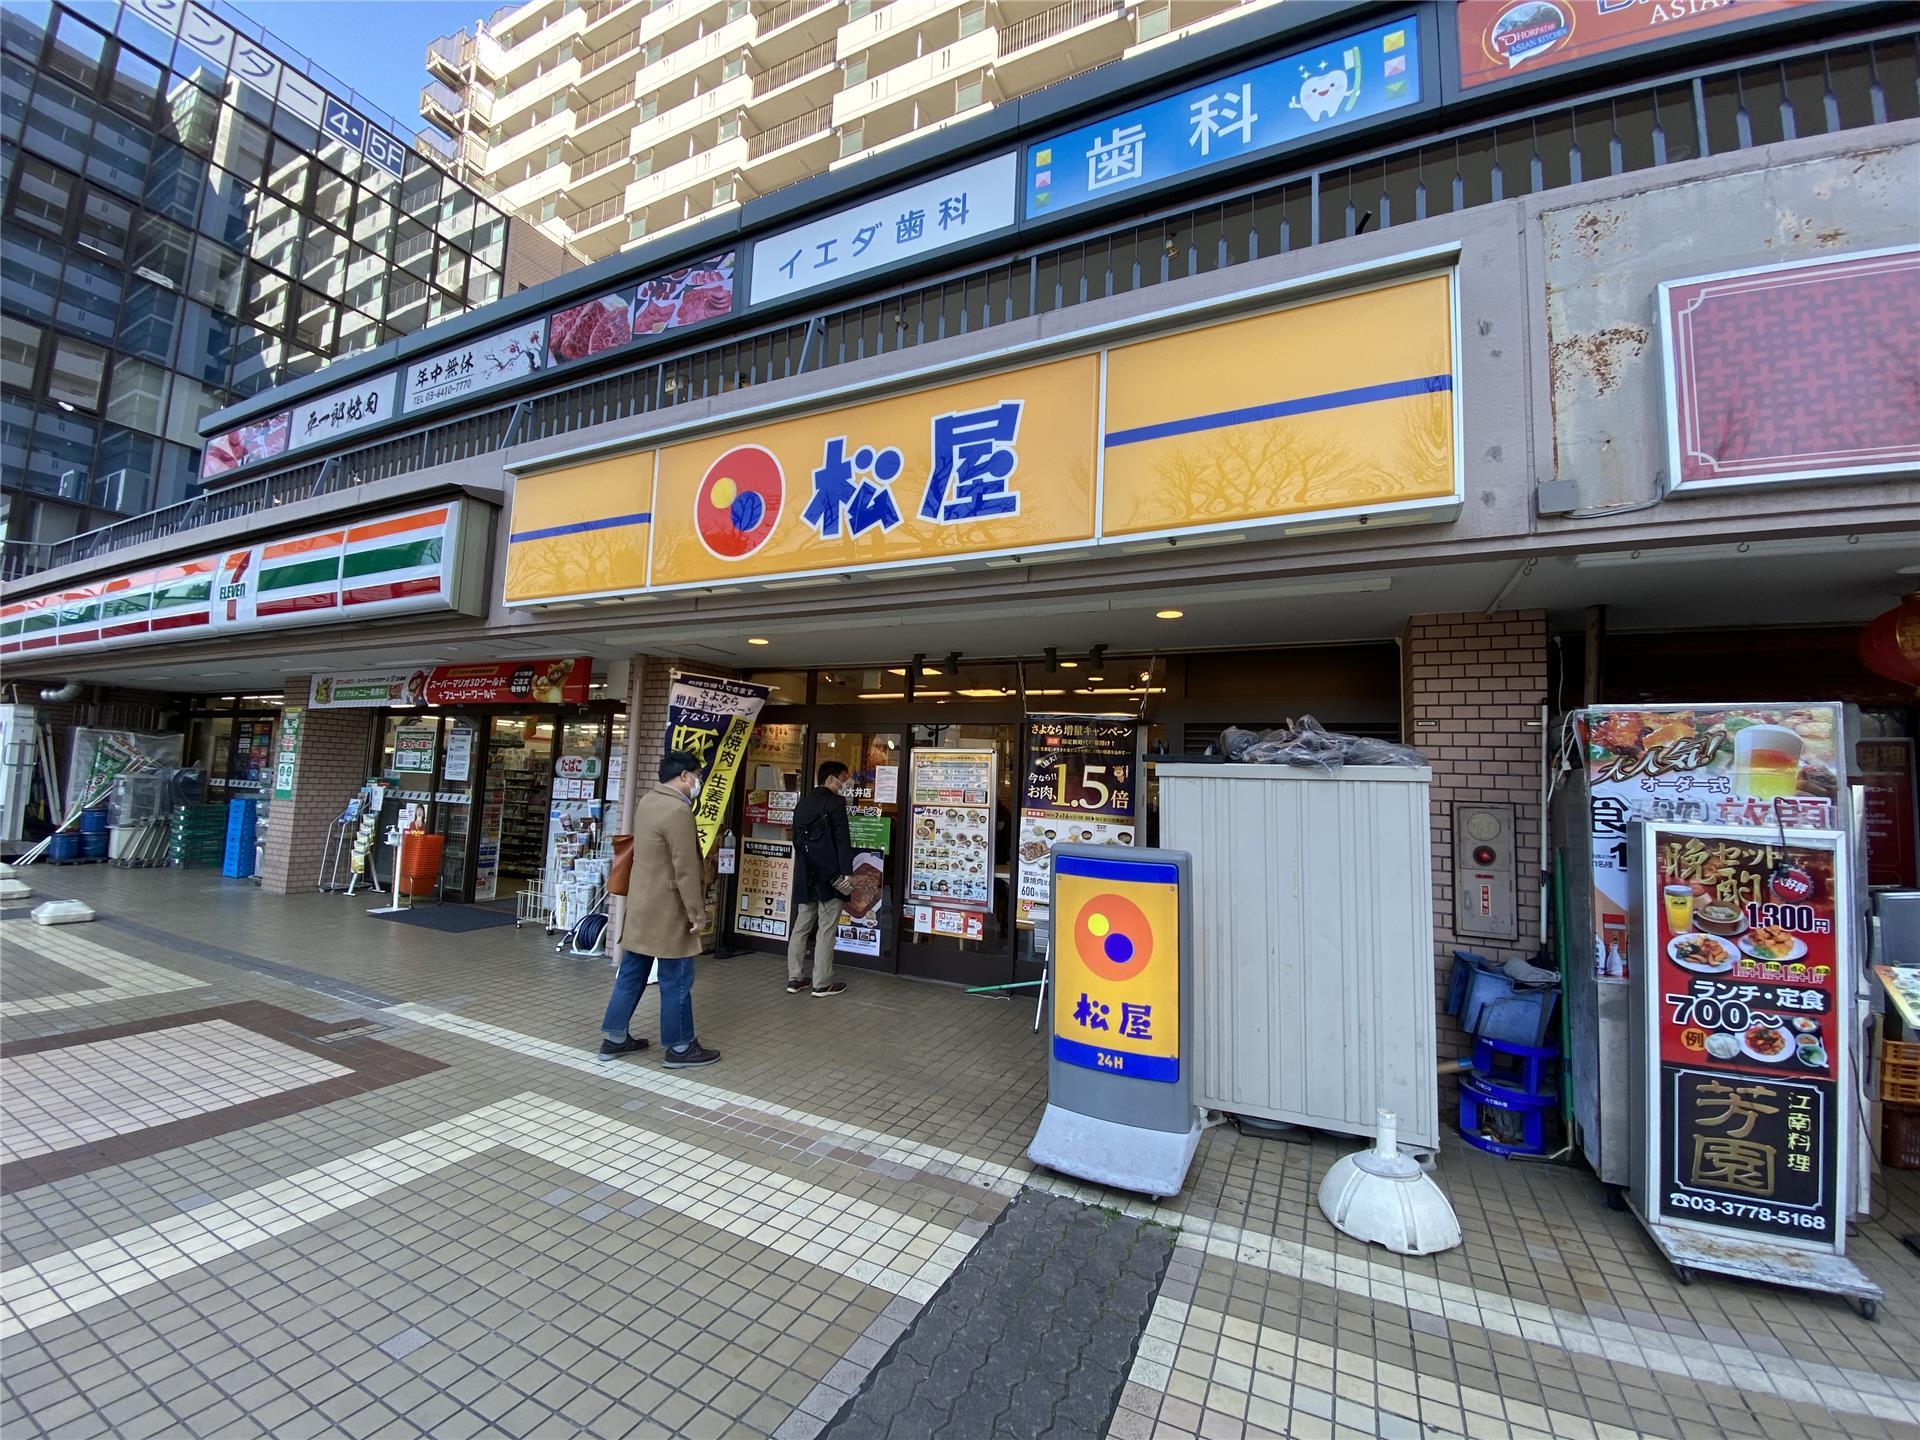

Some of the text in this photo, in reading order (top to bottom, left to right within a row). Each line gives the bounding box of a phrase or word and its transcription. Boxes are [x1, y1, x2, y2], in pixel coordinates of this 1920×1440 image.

[1086, 83, 1259, 192] 歯科
[777, 191, 971, 280] イエダ歯科
[415, 351, 475, 388] 年中無休
[414, 378, 472, 406] TEL 03-6410-7770
[800, 399, 1025, 540] 松屋
[676, 693, 754, 716] 増量キャンペーン
[700, 689, 739, 707] さよなら
[720, 718, 750, 768] 豚焼肉
[561, 758, 583, 773] たばこ
[1051, 763, 1109, 810] 1.5
[1110, 789, 1130, 810] 倍
[1641, 776, 1731, 794] オーダー式
[743, 868, 789, 880] MOBILE
[744, 858, 790, 870] MATSUYA
[742, 878, 789, 890] ORDER
[1746, 902, 1830, 934] 1,300円
[1694, 979, 1825, 1012] ランチ・定食
[1073, 992, 1153, 1041] 松屋
[1685, 1029, 1704, 1048] 例
[1097, 1052, 1124, 1070] 24H
[1690, 1080, 1780, 1197] 芳園
[1787, 1091, 1812, 1173] 江南料理
[1690, 1196, 1826, 1230] 03-3778-5168
